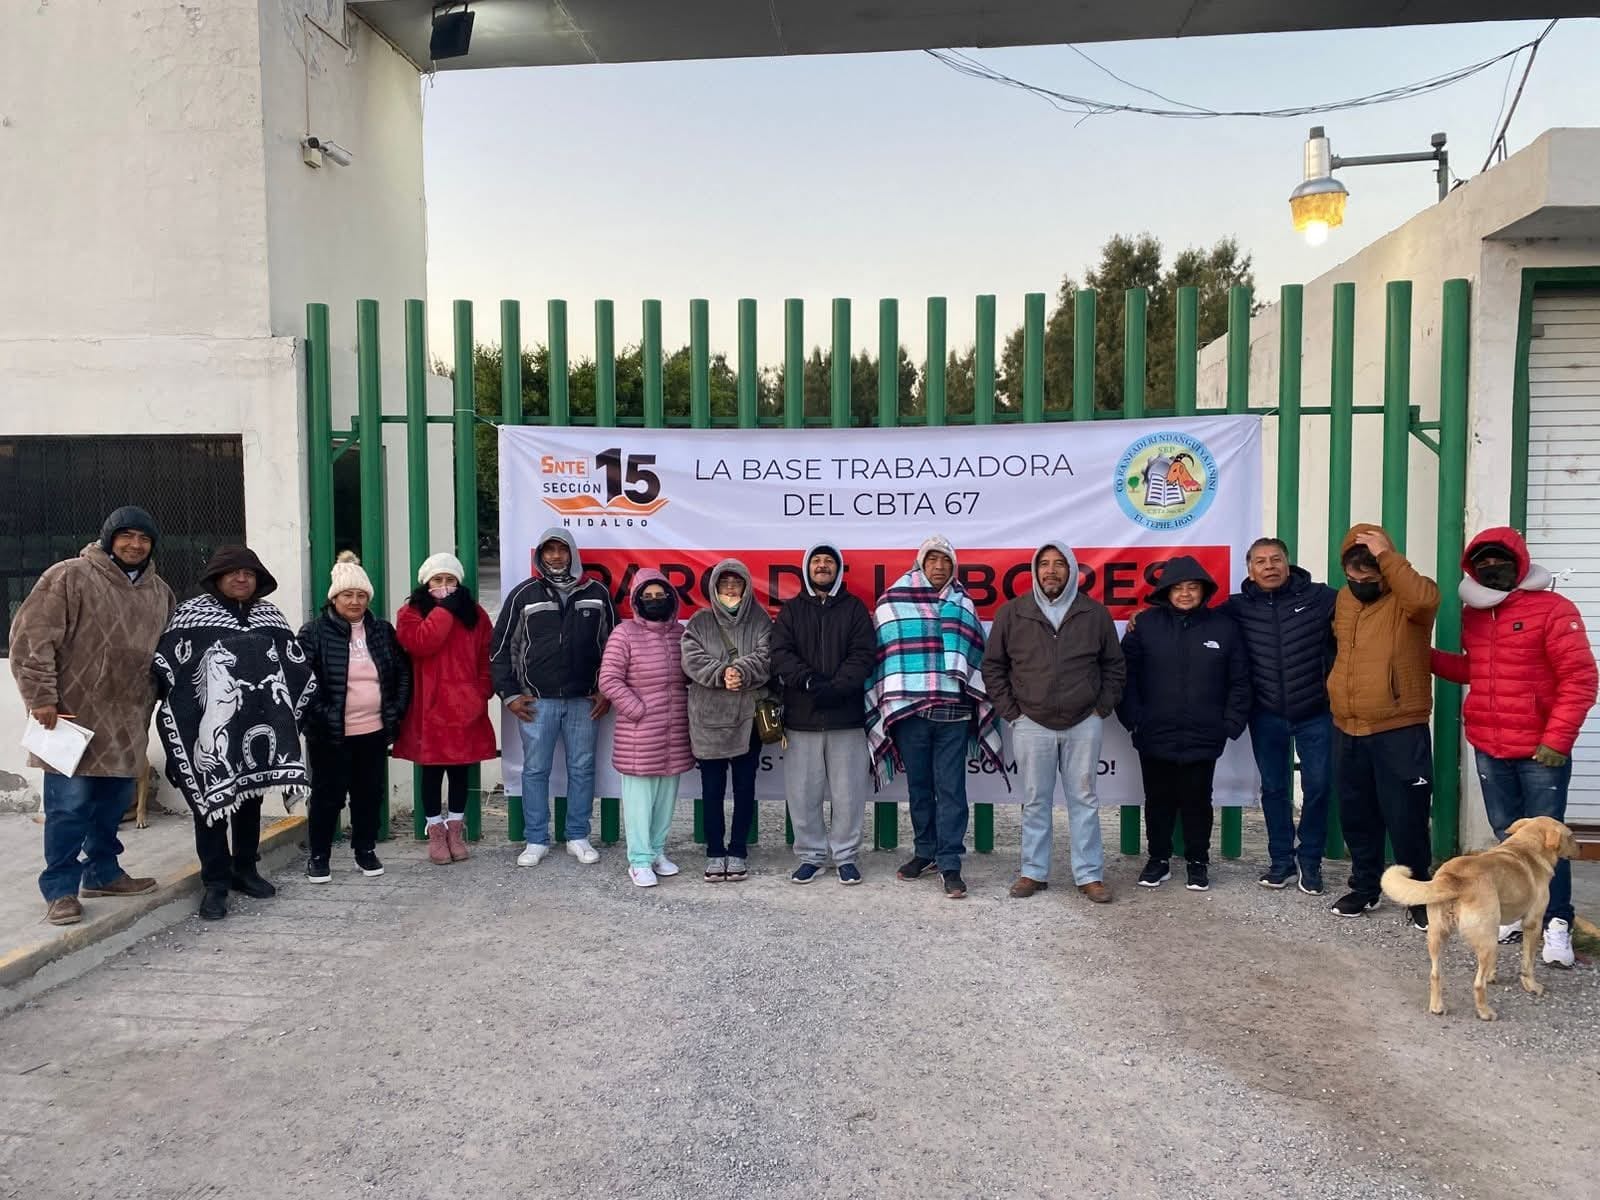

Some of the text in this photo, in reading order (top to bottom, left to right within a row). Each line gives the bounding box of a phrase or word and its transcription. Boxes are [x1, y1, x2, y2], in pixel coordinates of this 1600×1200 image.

[541, 456, 586, 475] SNTE
[595, 447, 661, 504] 15
[696, 453, 1074, 480] LA BASE TRABAJADORA
[543, 481, 601, 493] SECCIÓN
[784, 491, 980, 516] DEL CBTA 67
[563, 518, 648, 527] HIDALGO
